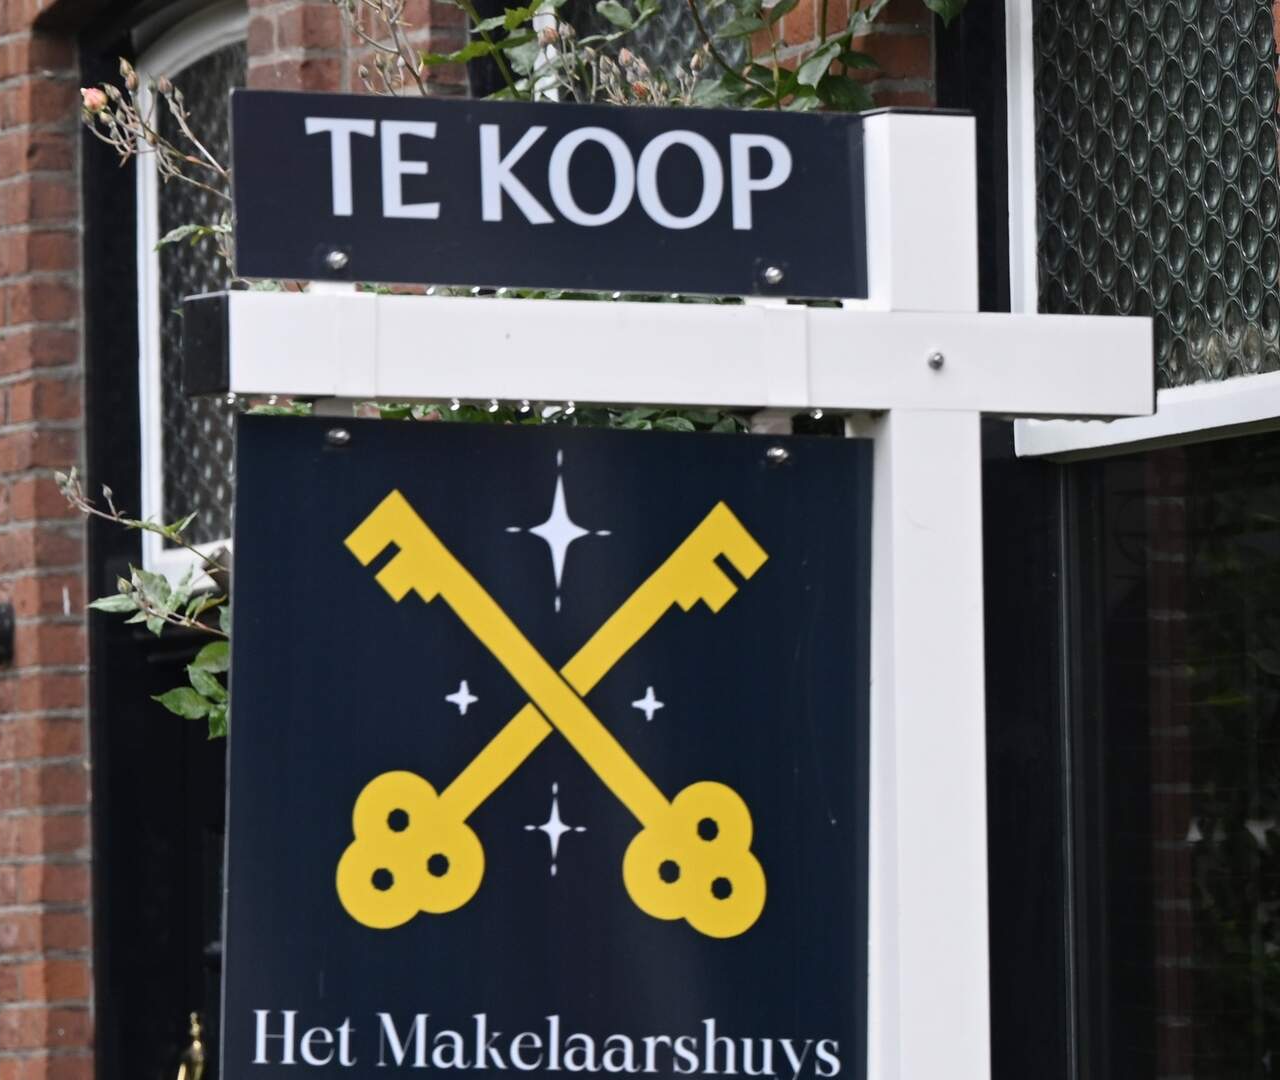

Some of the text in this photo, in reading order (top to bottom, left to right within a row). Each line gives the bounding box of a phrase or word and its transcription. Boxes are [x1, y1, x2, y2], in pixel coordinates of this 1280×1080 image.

[304, 116, 794, 232] TE KOOP
[252, 1008, 357, 1068] Het
